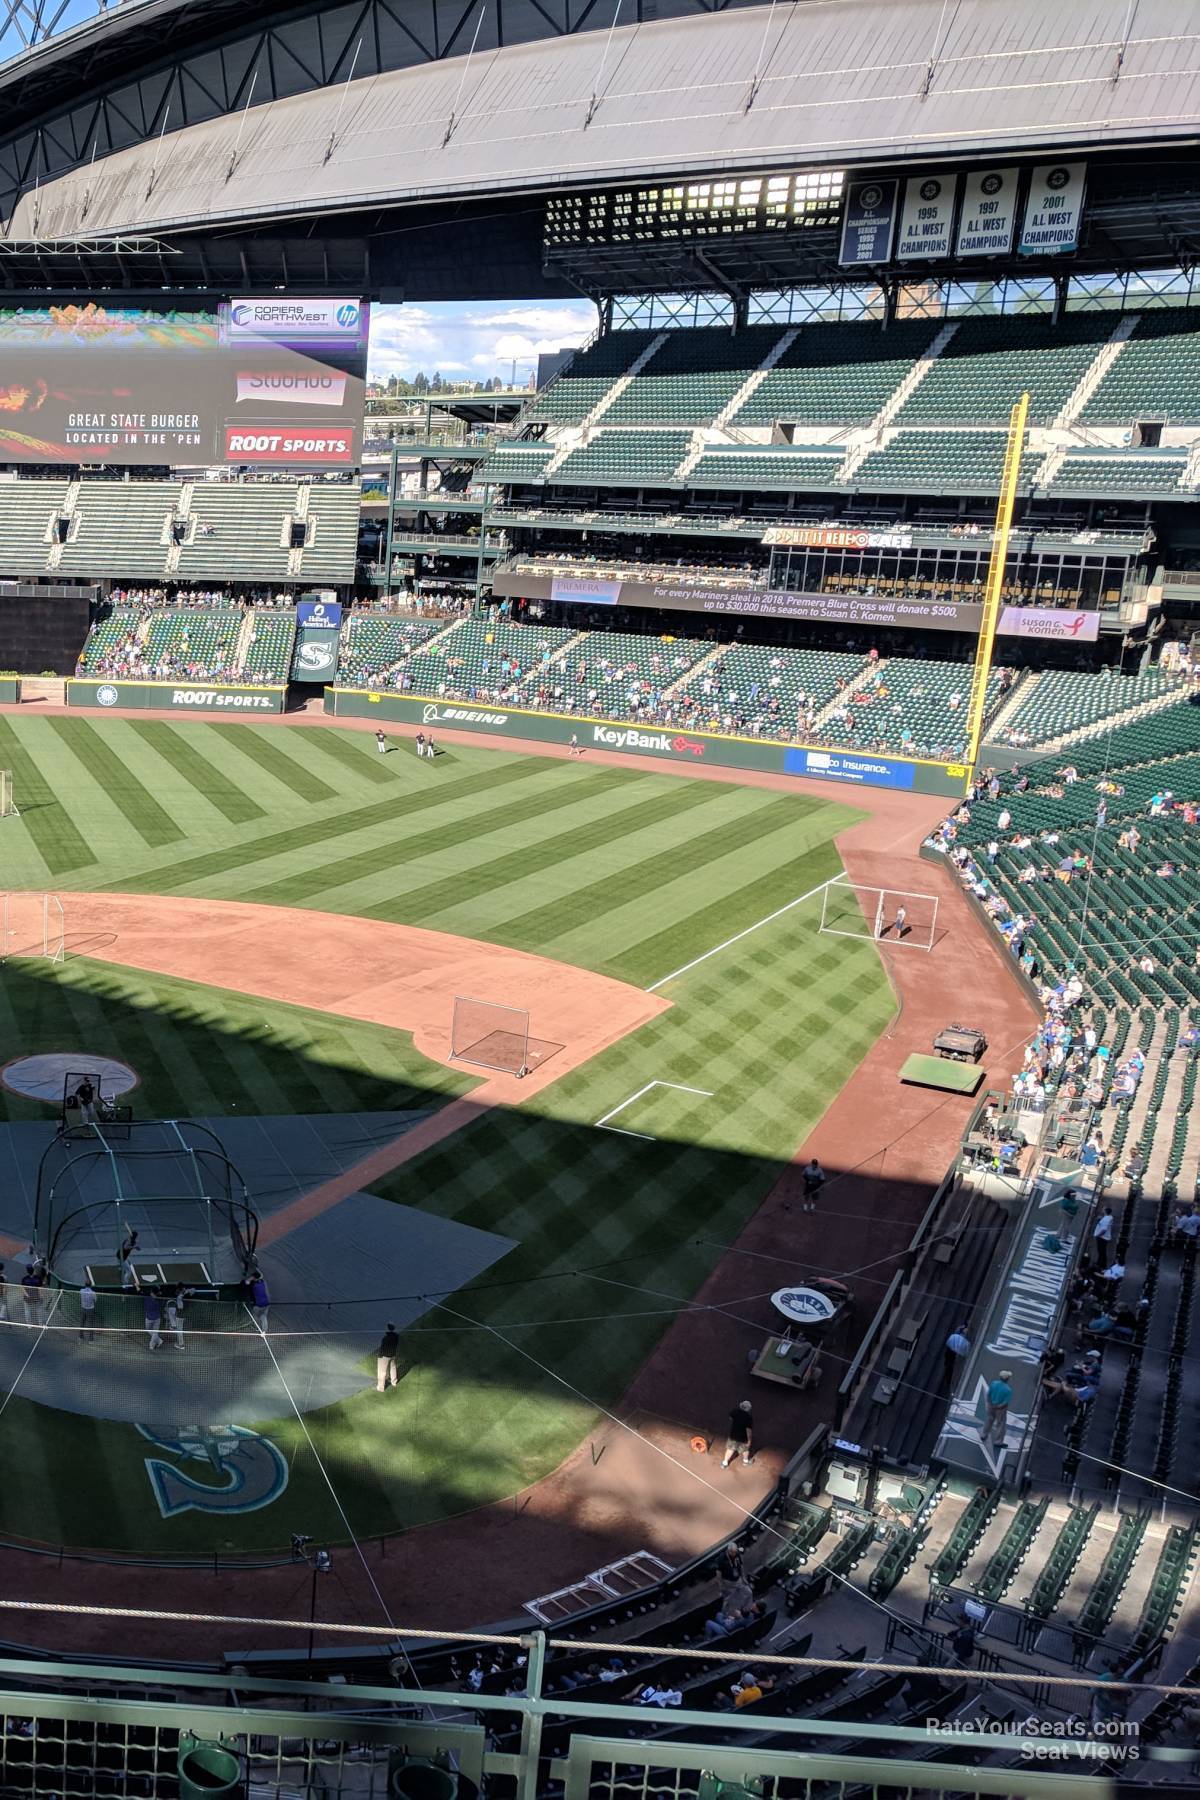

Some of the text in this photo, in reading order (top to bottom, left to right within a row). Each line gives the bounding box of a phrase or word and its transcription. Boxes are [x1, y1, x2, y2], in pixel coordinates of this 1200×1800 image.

[979, 201, 999, 215] 1997
[1043, 196, 1065, 209] 2001
[918, 207, 938, 219] 1995
[1032, 212, 1072, 226] A.L. WEST
[908, 223, 944, 236] A.L. WEST
[967, 218, 1006, 232] A.L. WEST
[860, 234, 875, 242] 1995
[960, 234, 1008, 250] CHAMPIONS
[1024, 229, 1074, 244] CHAMPIONS
[857, 243, 873, 251] 2000
[900, 239, 947, 253] CHAMPIONS
[856, 251, 873, 260] 2001
[340, 307, 356, 326] hp
[68, 414, 199, 428] GREAT STATE BURGER
[66, 433, 119, 443] LOCATED
[125, 434, 137, 444] IN
[144, 434, 166, 444] THE
[229, 436, 282, 451] ROOT
[792, 532, 809, 544] HIT
[813, 533, 822, 545] IT
[557, 582, 600, 592] PREMERA
[653, 587, 958, 617] For every Mariners steal in 2018, Premera Blue Cross will donate $500,
[703, 602, 715, 610] up
[725, 601, 759, 612] $30,000
[760, 603, 776, 613] this
[776, 607, 808, 616] season
[810, 608, 819, 616] to
[820, 608, 848, 619] Susan
[850, 610, 859, 620] G.
[861, 612, 897, 622] Komen.
[1021, 617, 1054, 627] susan
[173, 691, 216, 705] ROOT
[442, 708, 509, 725] BOEING
[594, 726, 672, 752] KeyBank
[842, 759, 887, 773] Insurance
[986, 1293, 1057, 1366] SEATTLE
